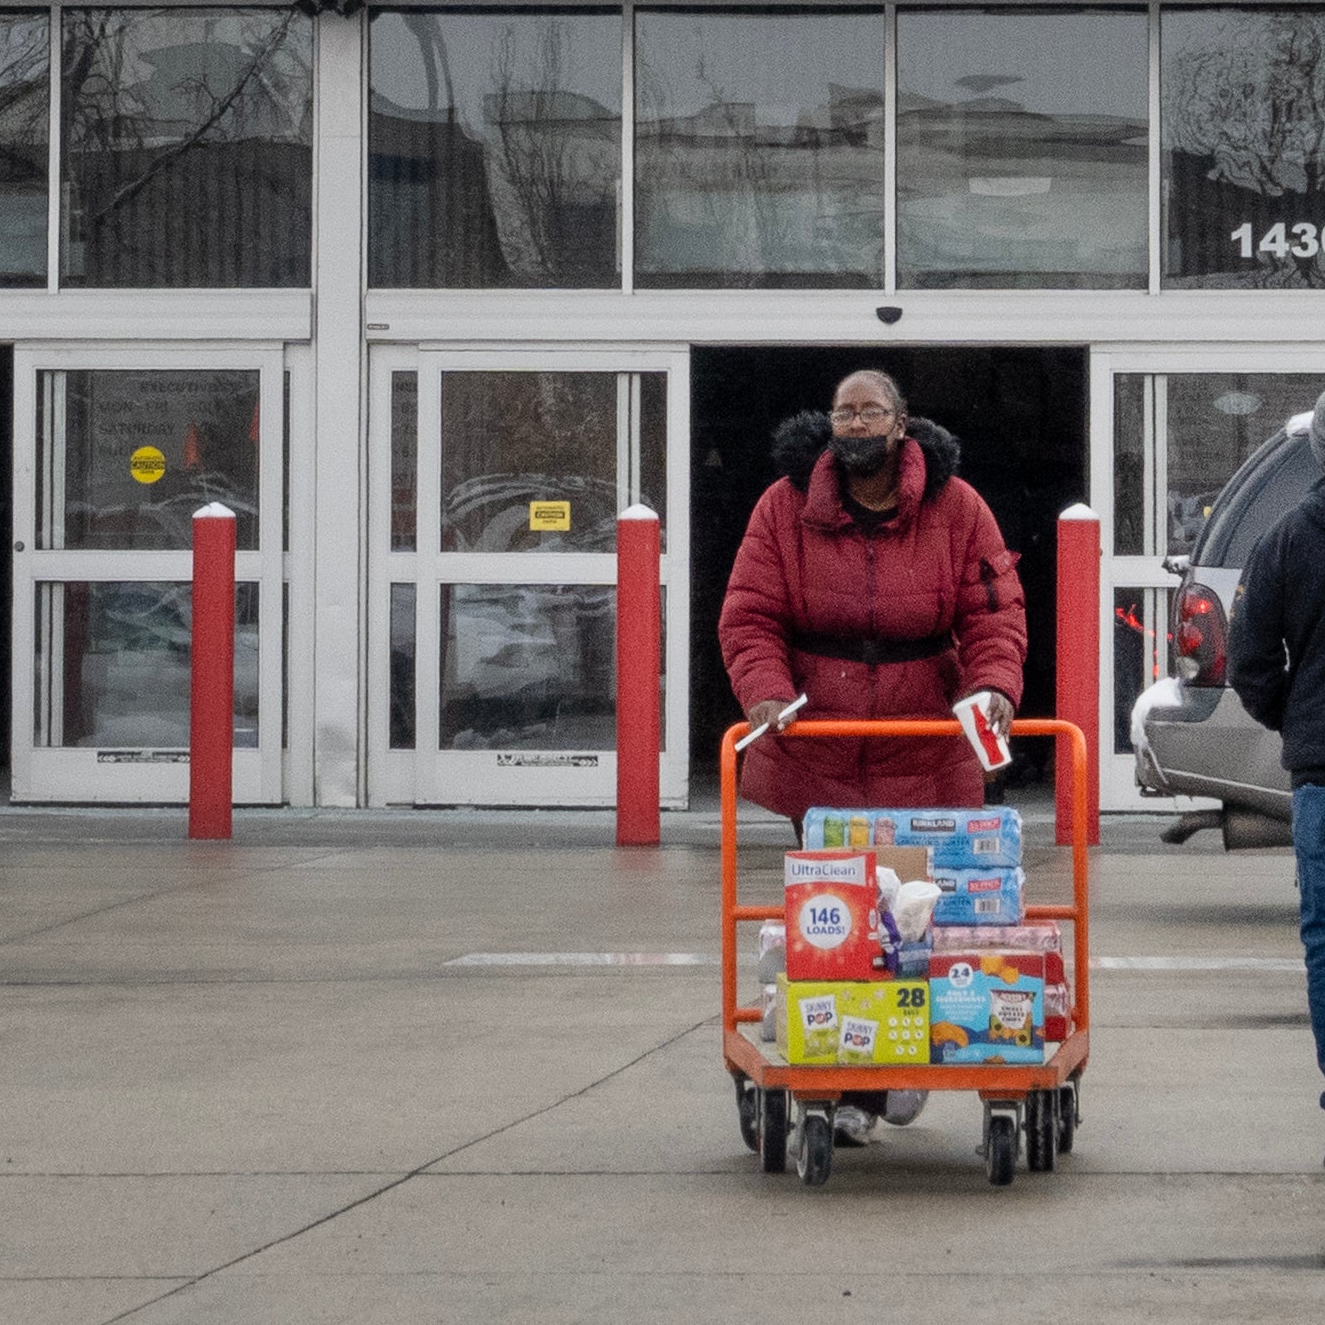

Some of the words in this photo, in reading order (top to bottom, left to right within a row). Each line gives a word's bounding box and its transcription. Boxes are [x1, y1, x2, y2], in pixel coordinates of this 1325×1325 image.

[791, 864, 856, 876] UltraClean
[810, 907, 841, 925] 146
[806, 926, 846, 935] LOADS!
[951, 967, 970, 979] 24
[897, 988, 925, 1008] 28
[805, 1001, 832, 1013] SKINNY
[806, 1011, 833, 1026] POP
[843, 1032, 871, 1047] POP
